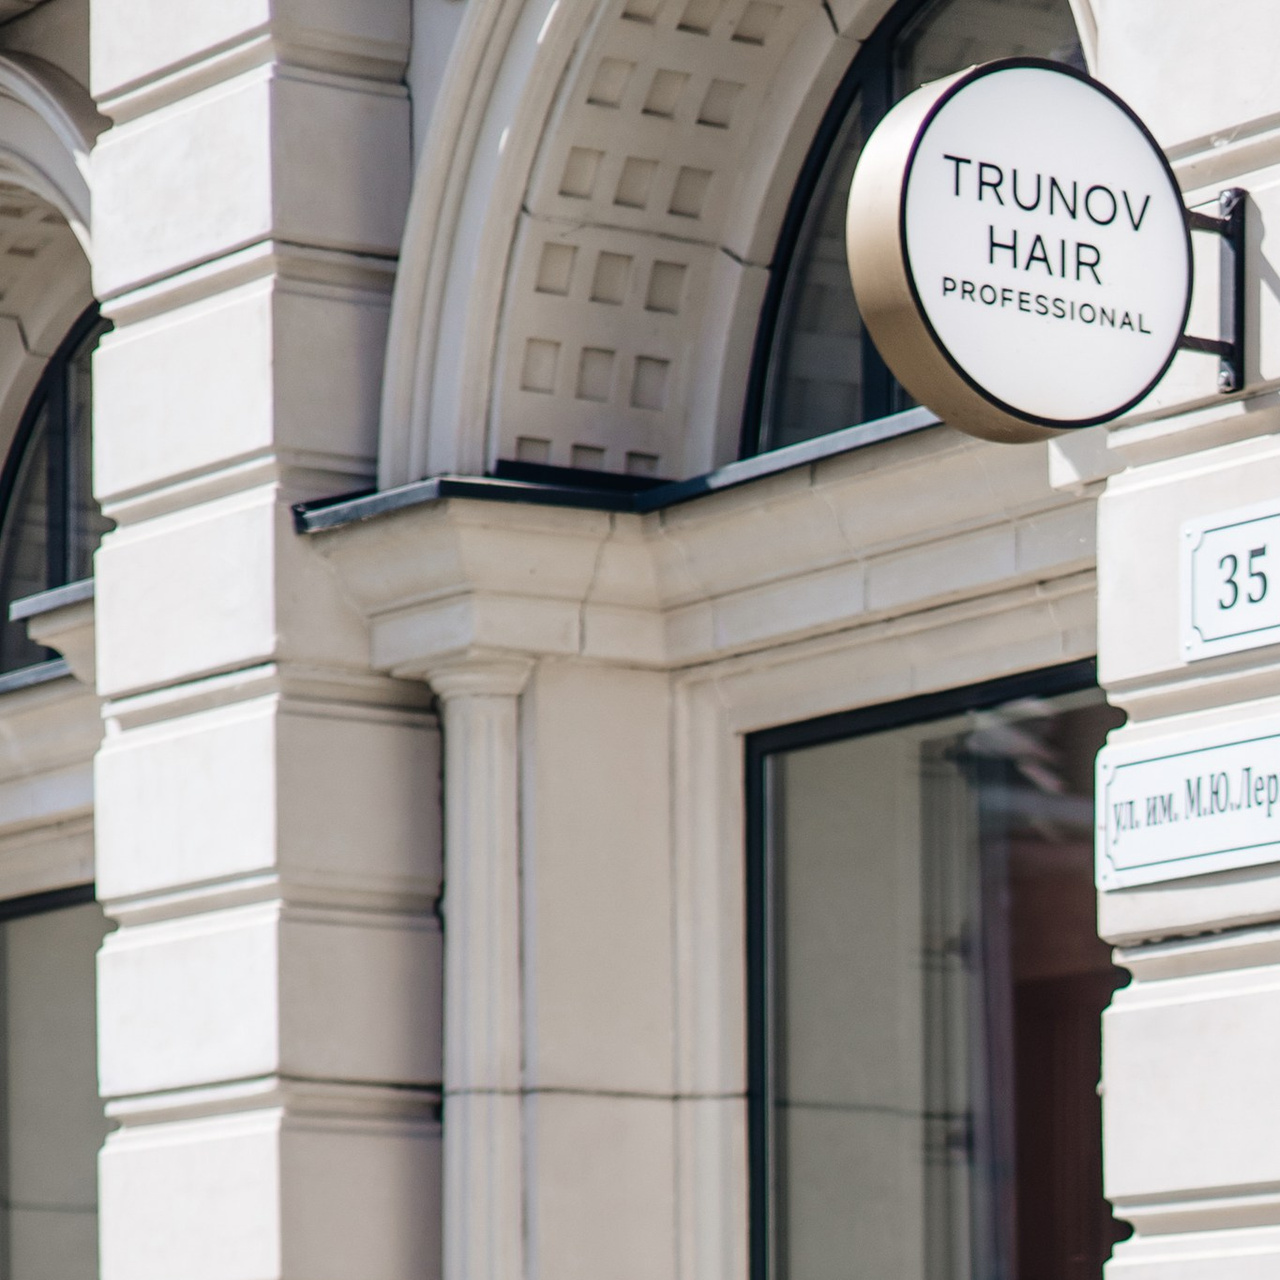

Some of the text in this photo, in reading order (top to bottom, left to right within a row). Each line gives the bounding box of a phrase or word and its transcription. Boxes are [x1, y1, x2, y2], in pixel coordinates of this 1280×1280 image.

[943, 153, 1151, 231] TRUNOV
[988, 224, 1102, 285] HAIR
[942, 276, 1151, 335] PROFESSIONAL
[1218, 543, 1269, 611] 35
[1113, 800, 1140, 844] ул.
[1146, 793, 1178, 823] им.
